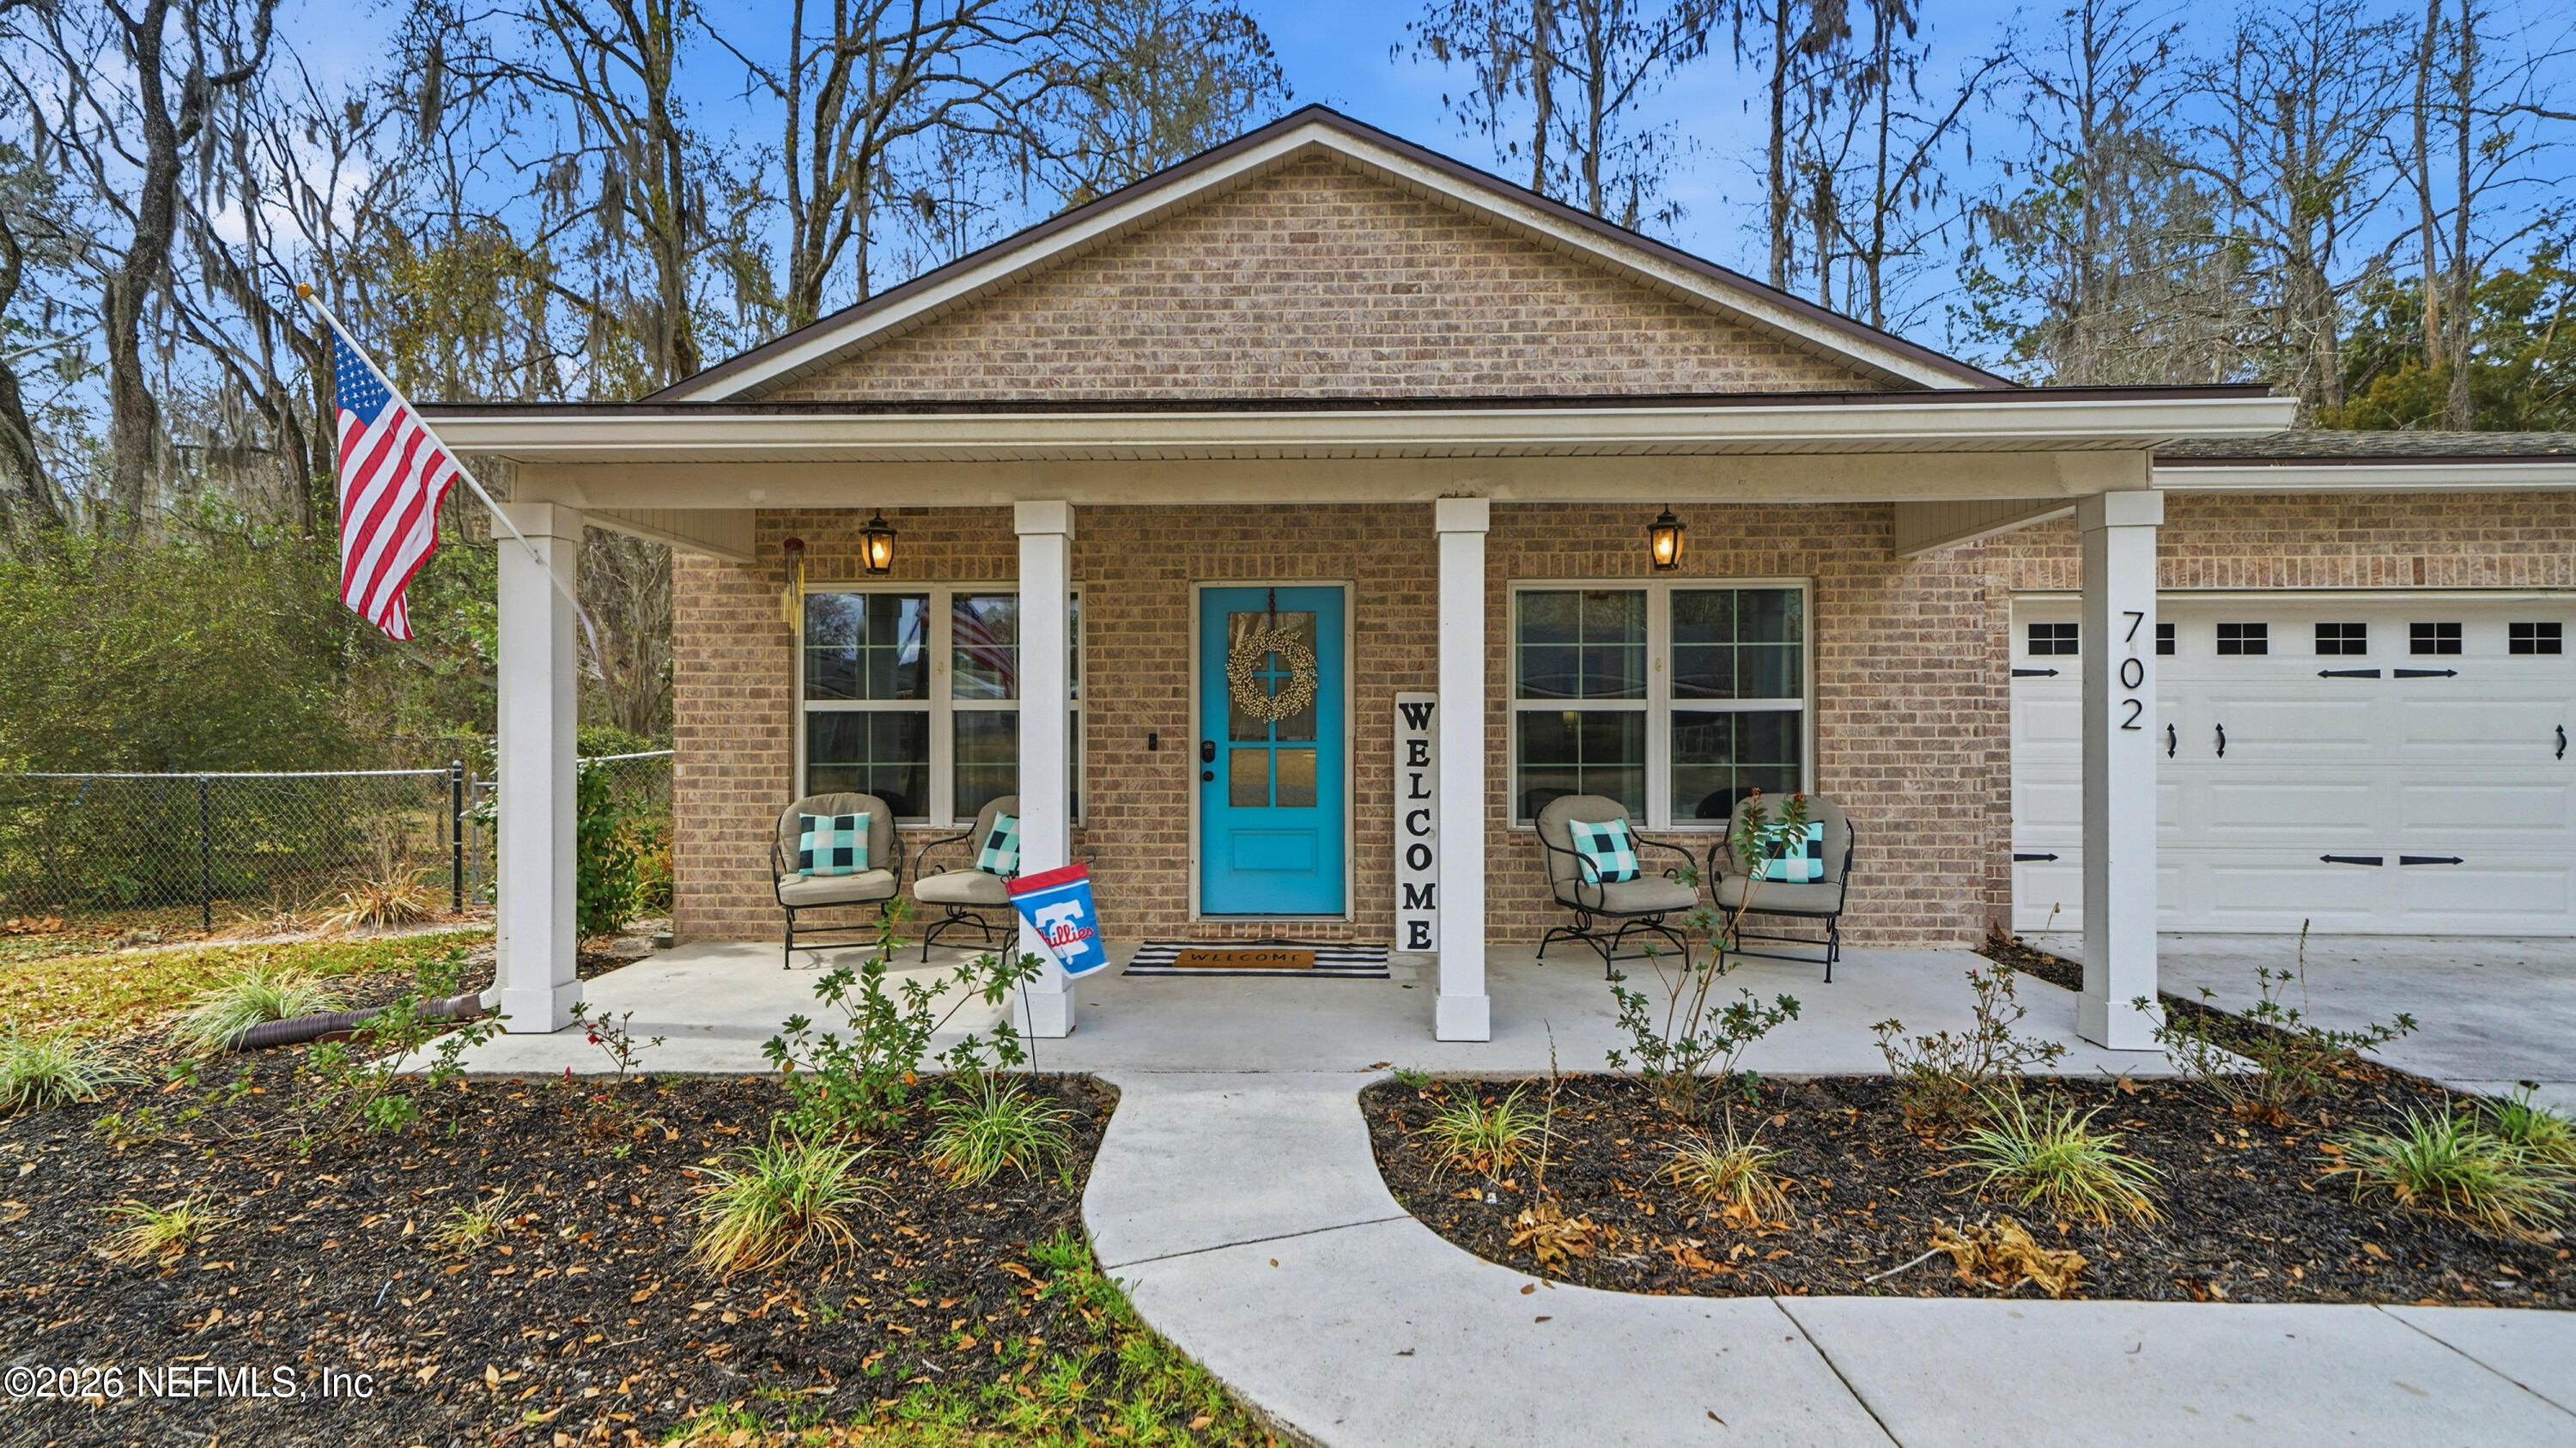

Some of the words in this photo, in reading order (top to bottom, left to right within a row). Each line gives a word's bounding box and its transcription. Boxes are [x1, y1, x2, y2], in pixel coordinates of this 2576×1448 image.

[2120, 611, 2145, 730] 702
[1398, 703, 1436, 950] WELCOME
[1191, 953, 1302, 962] WELCOME
